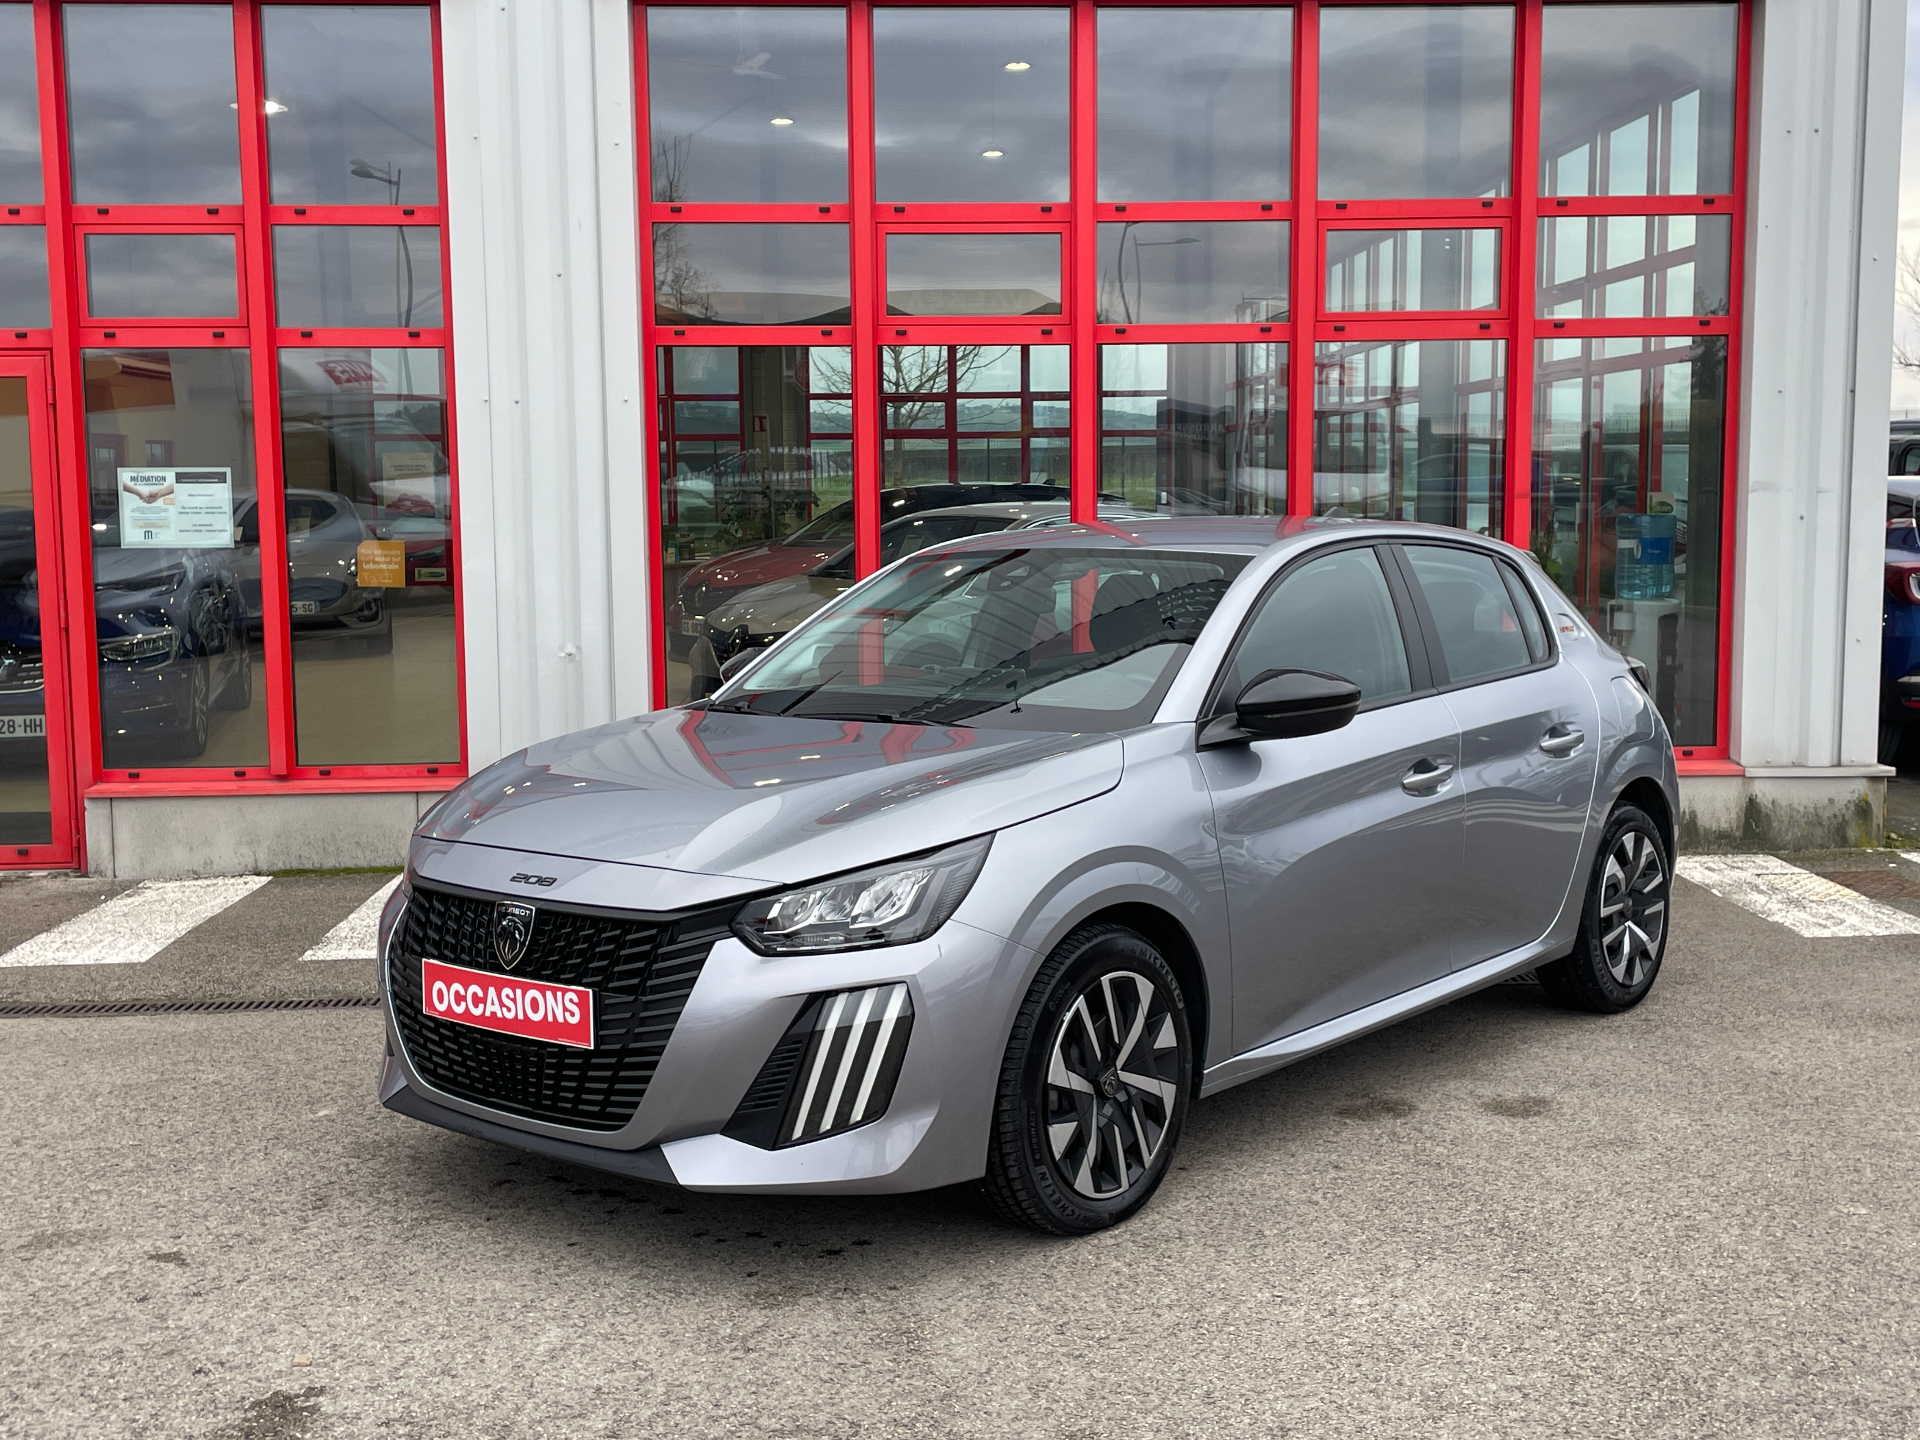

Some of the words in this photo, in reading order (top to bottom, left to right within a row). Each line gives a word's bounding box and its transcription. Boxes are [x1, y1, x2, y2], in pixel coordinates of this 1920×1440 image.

[130, 473, 167, 483] MÉDIATION
[362, 562, 400, 570] leboncoin
[0, 718, 43, 734] 28-HH
[509, 872, 558, 887] 208
[1139, 946, 1183, 1004] MICHELIN
[431, 980, 581, 1025] OCCASIONS
[1039, 1171, 1094, 1225] MICHELIN
